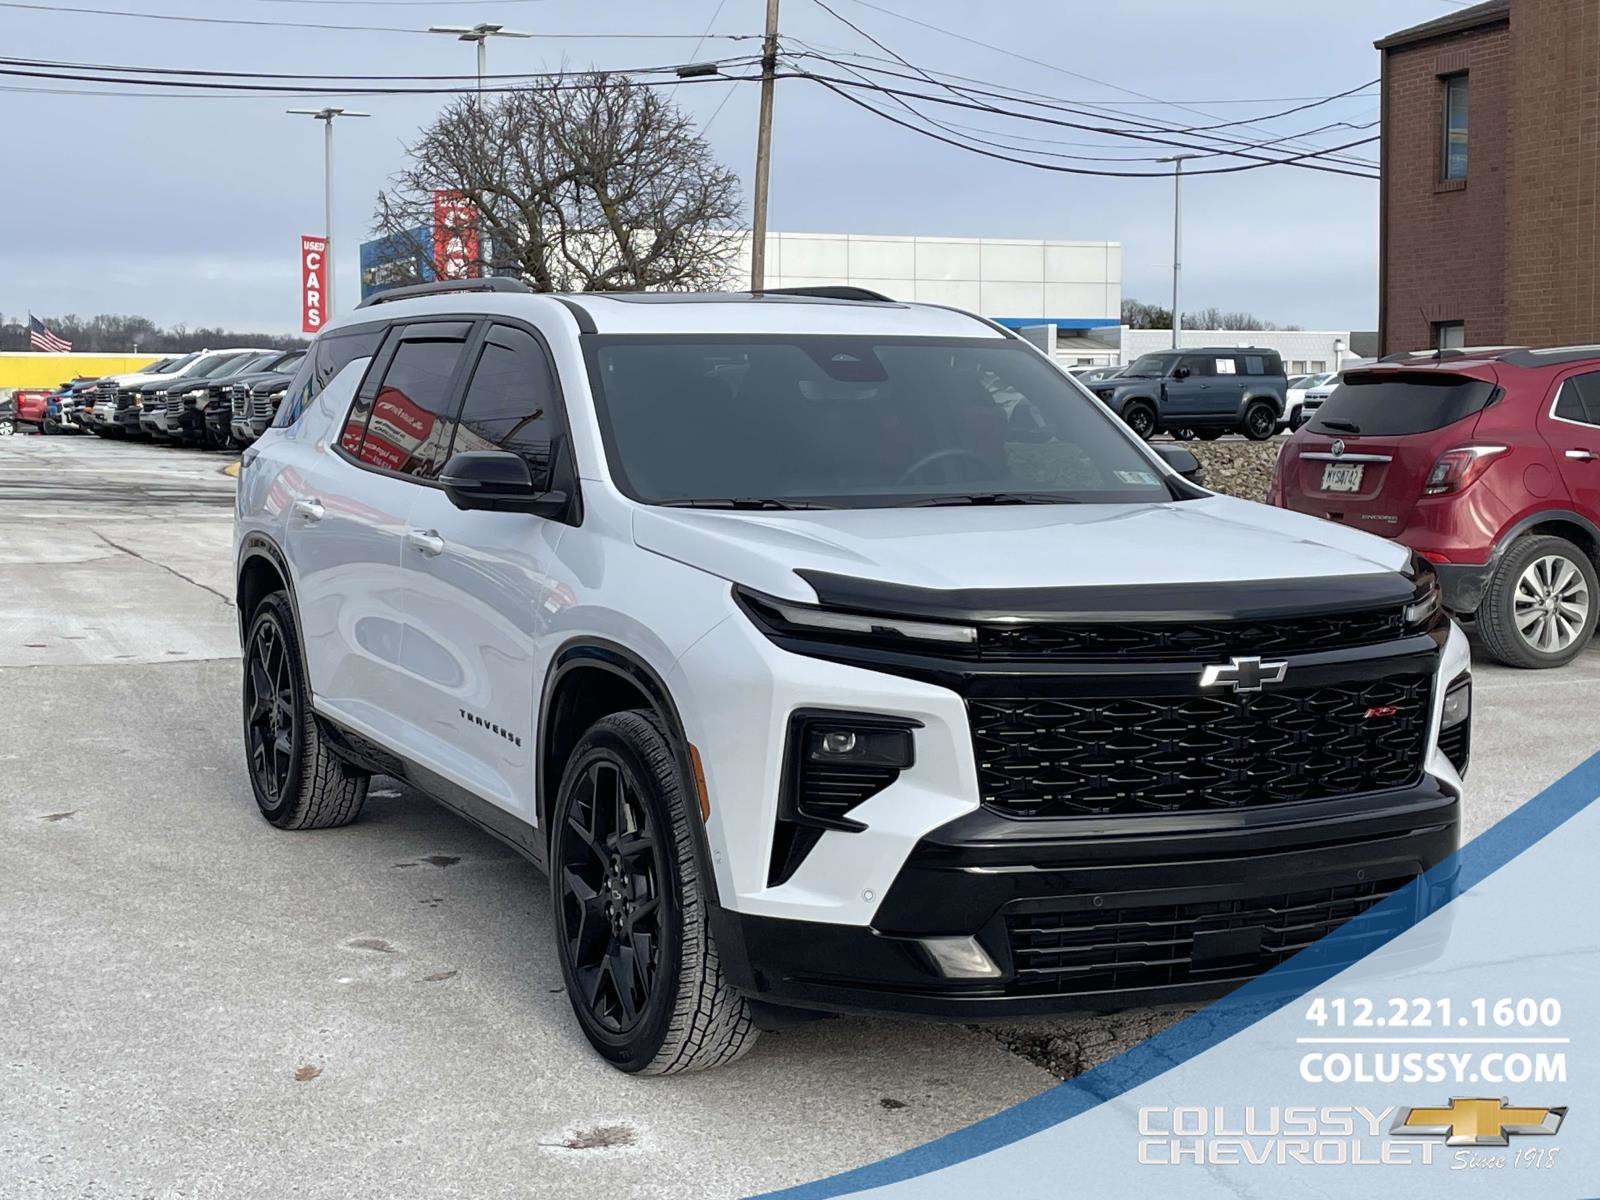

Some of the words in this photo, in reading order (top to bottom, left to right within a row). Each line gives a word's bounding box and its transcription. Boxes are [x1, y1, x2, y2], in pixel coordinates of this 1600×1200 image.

[303, 241, 325, 252] USED
[306, 252, 321, 326] CARS
[459, 708, 522, 747] TRAVERSE
